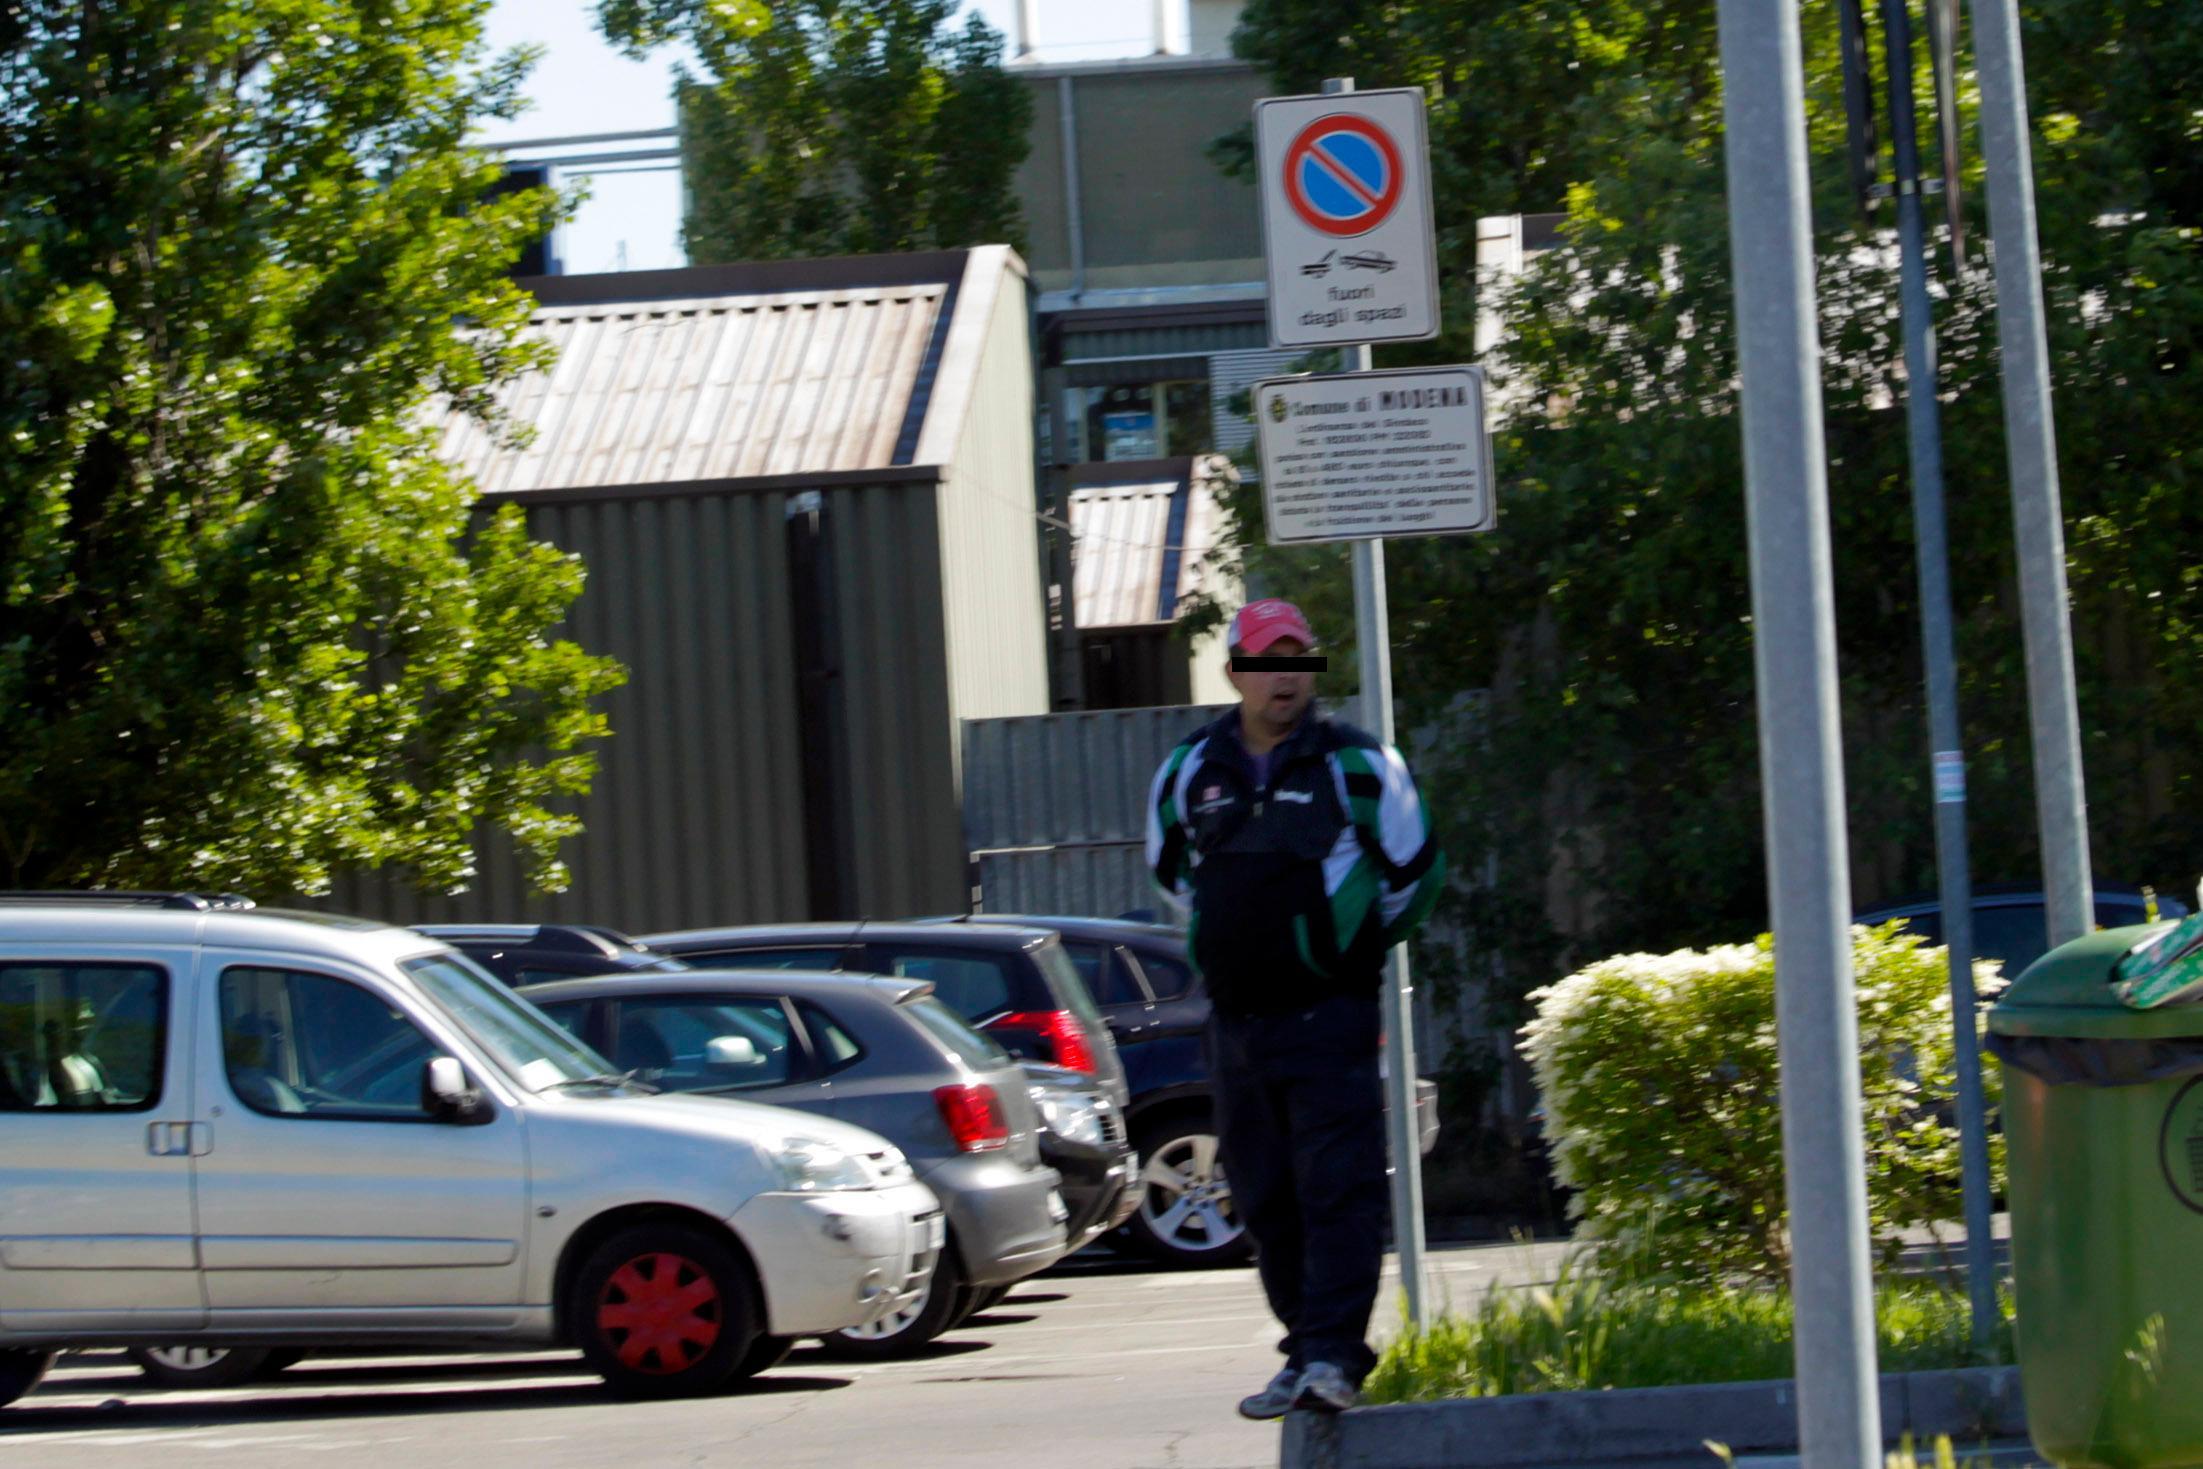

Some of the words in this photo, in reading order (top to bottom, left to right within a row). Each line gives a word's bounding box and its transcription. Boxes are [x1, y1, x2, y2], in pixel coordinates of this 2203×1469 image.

[1327, 284, 1375, 300] fuori
[1298, 307, 1349, 328] dagli
[1354, 303, 1407, 325] spazi
[1290, 400, 1349, 416] Comune
[1354, 397, 1372, 413] di
[1378, 386, 1467, 411] MODENA
